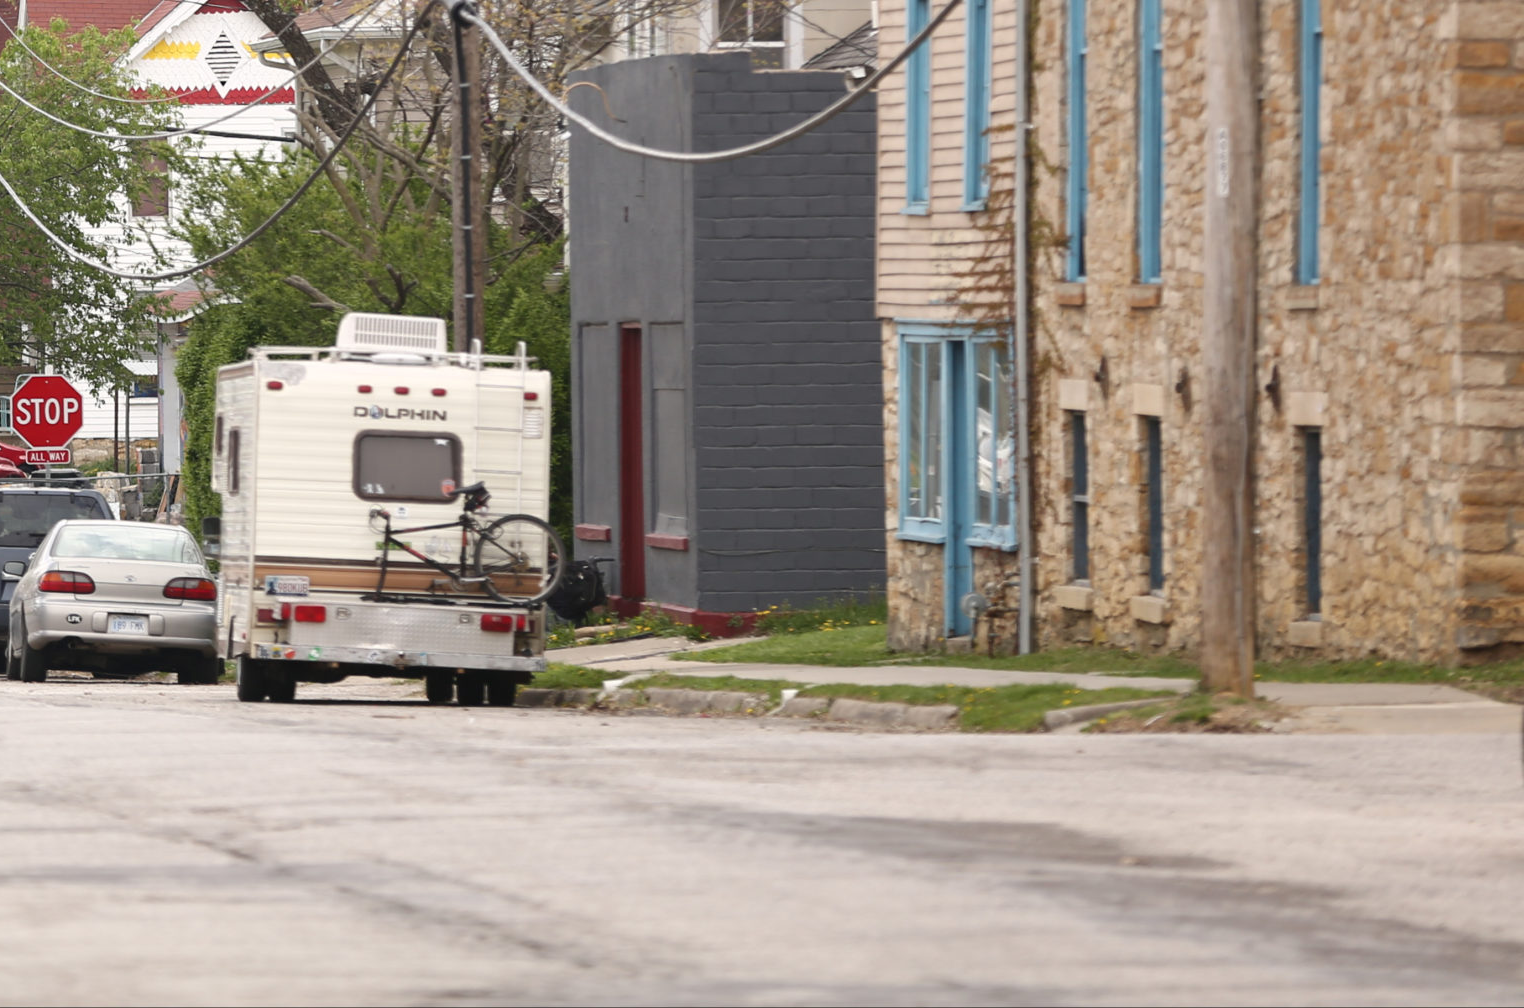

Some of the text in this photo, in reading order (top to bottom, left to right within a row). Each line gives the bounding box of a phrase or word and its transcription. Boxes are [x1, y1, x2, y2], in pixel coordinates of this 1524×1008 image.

[16, 397, 79, 425] STOP
[353, 405, 448, 421] DOLPHIN
[30, 452, 66, 461] ALL WAY
